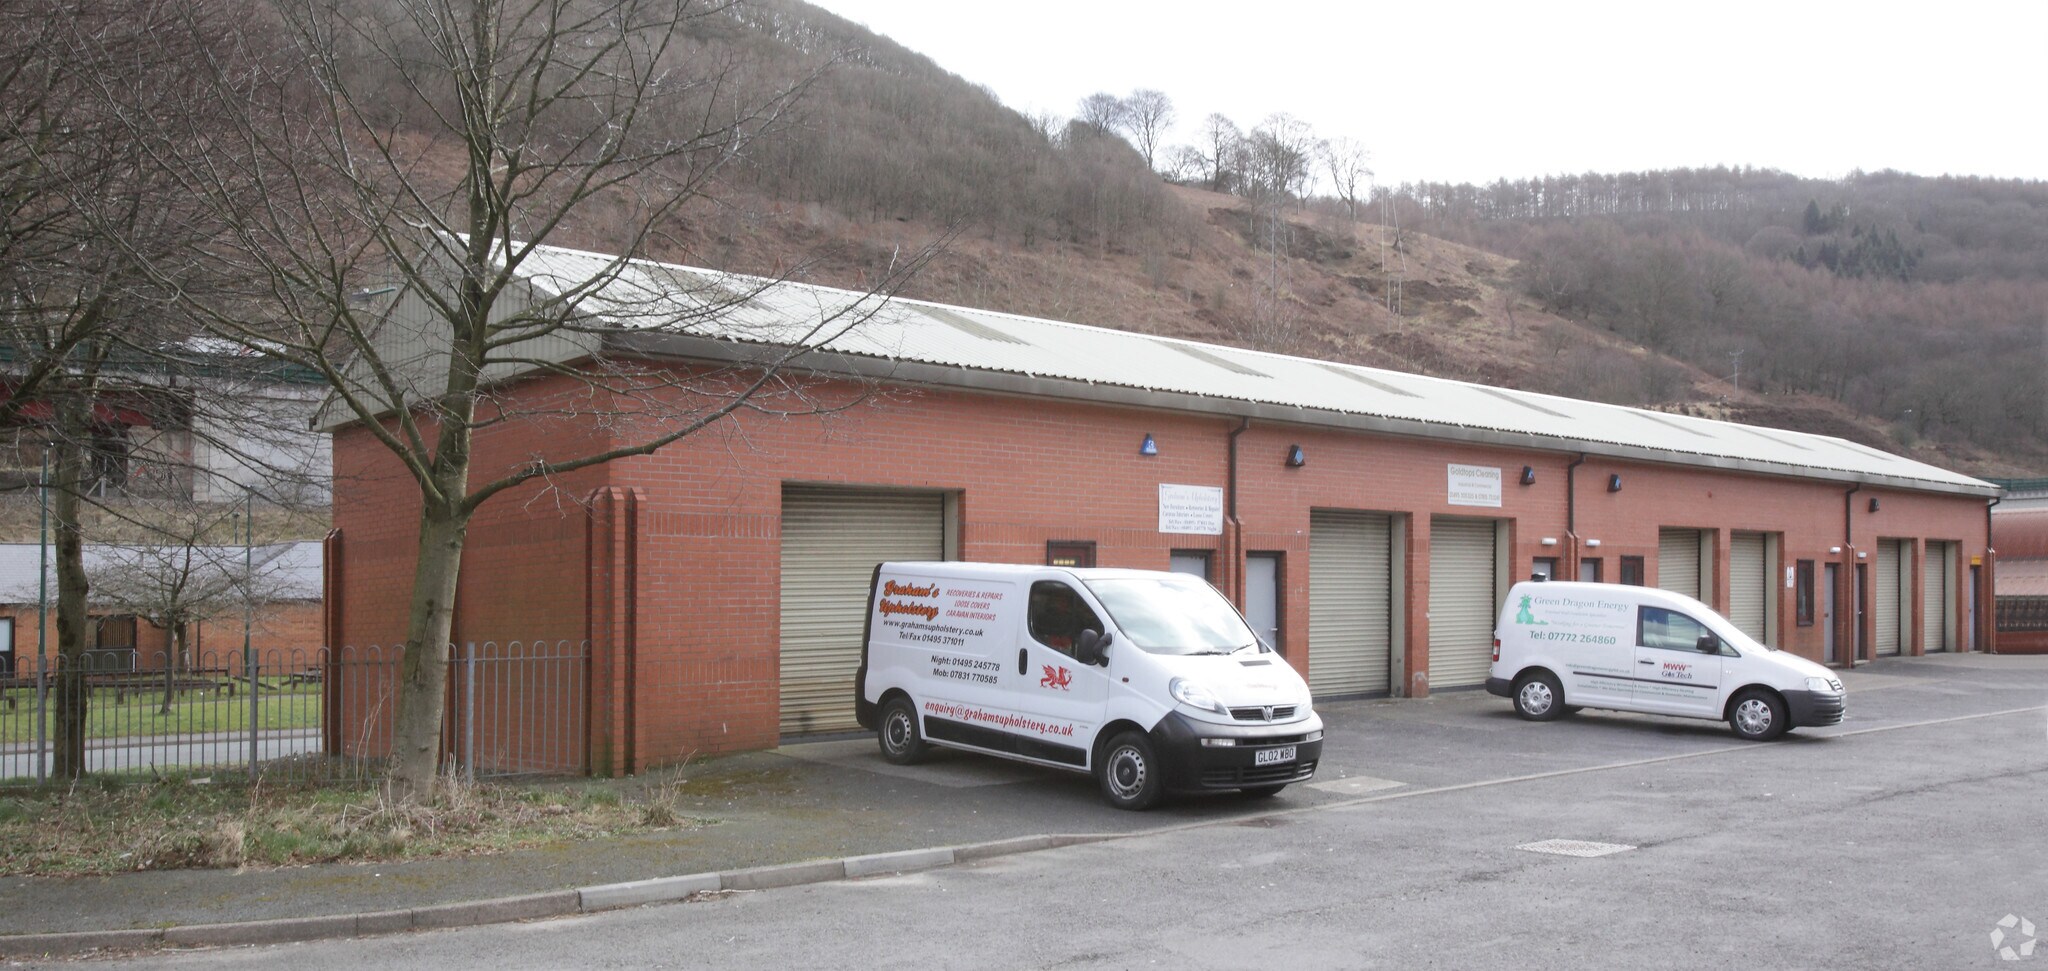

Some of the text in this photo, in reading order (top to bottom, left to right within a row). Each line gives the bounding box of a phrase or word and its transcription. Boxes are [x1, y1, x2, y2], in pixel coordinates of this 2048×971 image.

[884, 579, 940, 598] Graham's
[945, 588, 976, 599] RECOVERIES
[981, 591, 1003, 600] REPAIRS
[879, 598, 939, 621] Upholstery
[954, 600, 991, 610] LOOSE COVERS
[1534, 596, 1629, 612] Green Dragon Energy
[945, 609, 997, 621] CARAVAN INTERIORS
[883, 619, 984, 637] www.grahamsupholstery.co.uk
[922, 634, 942, 644] 01495
[943, 636, 965, 647] 371011
[1530, 630, 1616, 645] Tel: 07772 264860
[931, 655, 1000, 672] Night: 01495 245778
[1663, 662, 1686, 671] MWW
[932, 668, 998, 684] Mob: 07831 770585
[1676, 671, 1693, 680] Tech
[925, 701, 1074, 737] enquiry@grahamsupholstery.co.uk
[1258, 750, 1278, 763] GL02
